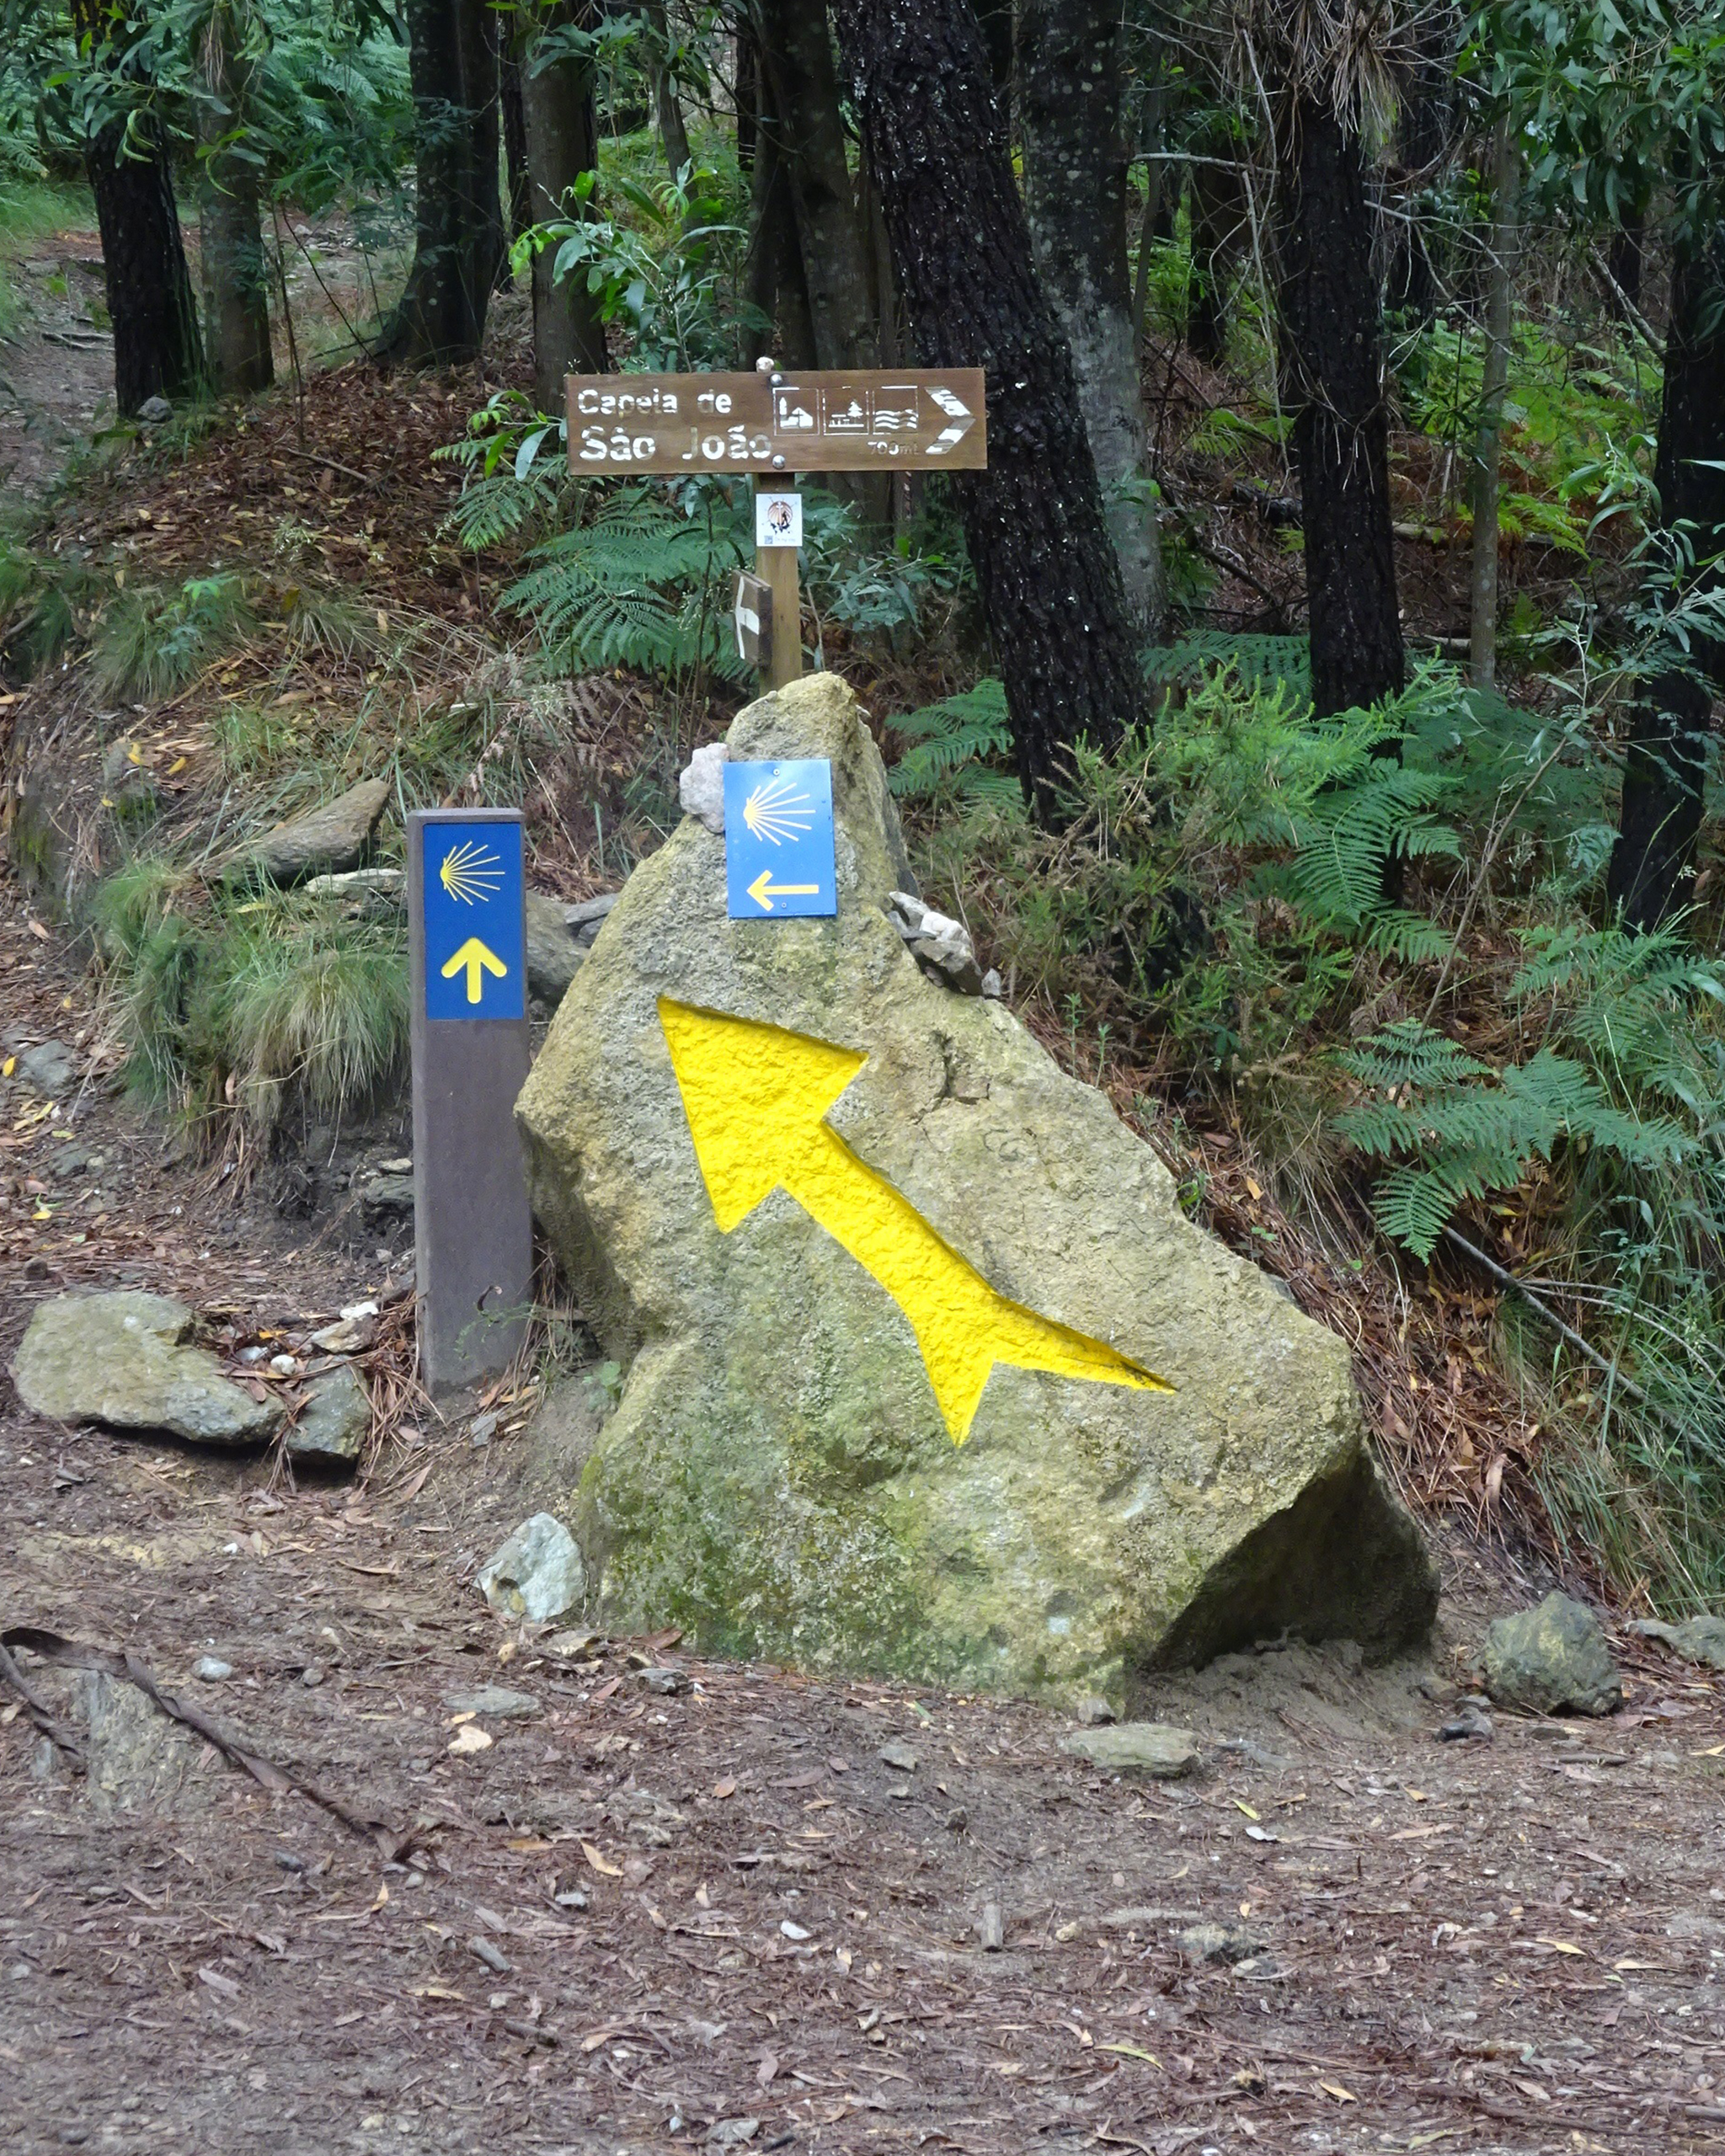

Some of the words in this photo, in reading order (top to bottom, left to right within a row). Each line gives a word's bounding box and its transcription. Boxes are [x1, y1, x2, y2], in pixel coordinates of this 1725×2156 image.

[697, 388, 732, 414] de
[579, 425, 656, 460] São
[682, 424, 772, 460] João
